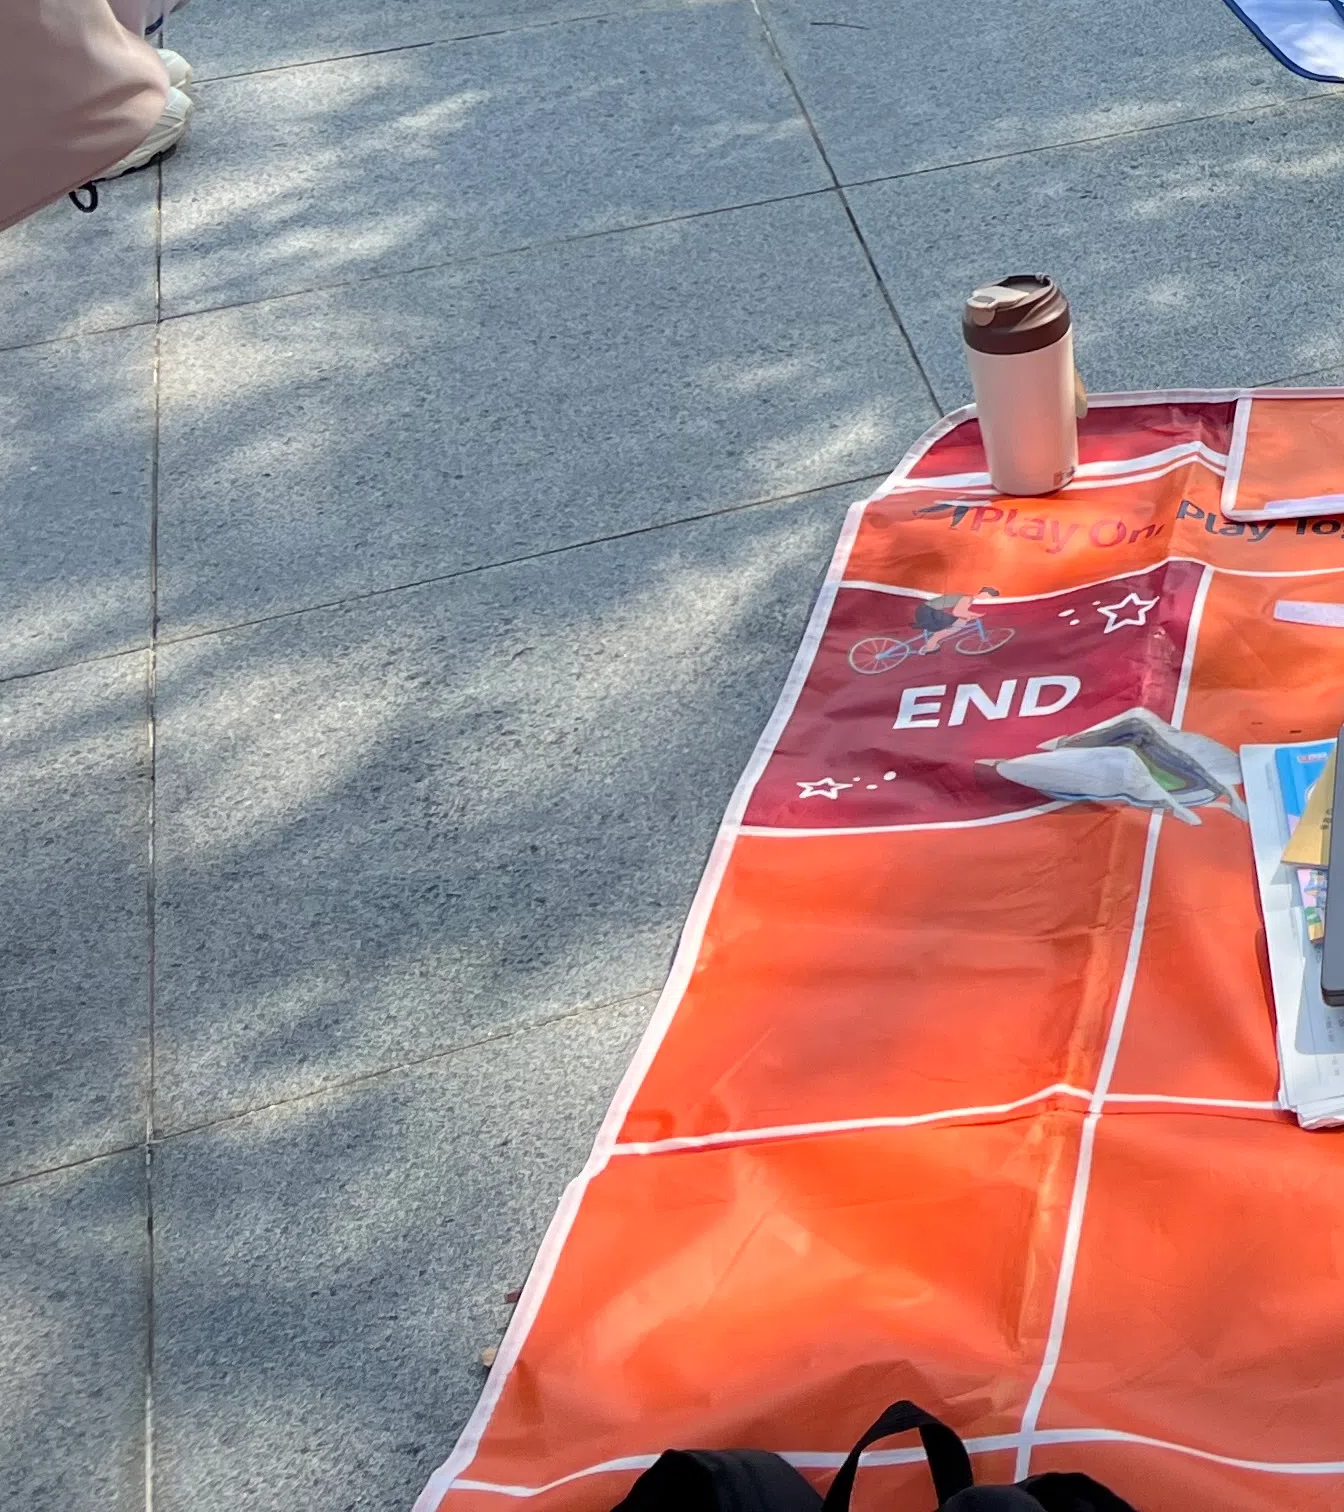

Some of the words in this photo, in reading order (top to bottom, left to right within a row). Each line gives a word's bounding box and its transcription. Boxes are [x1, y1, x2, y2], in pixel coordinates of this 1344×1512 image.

[970, 505, 1066, 556] Play
[1176, 499, 1275, 543] Play
[891, 672, 1081, 730] END
